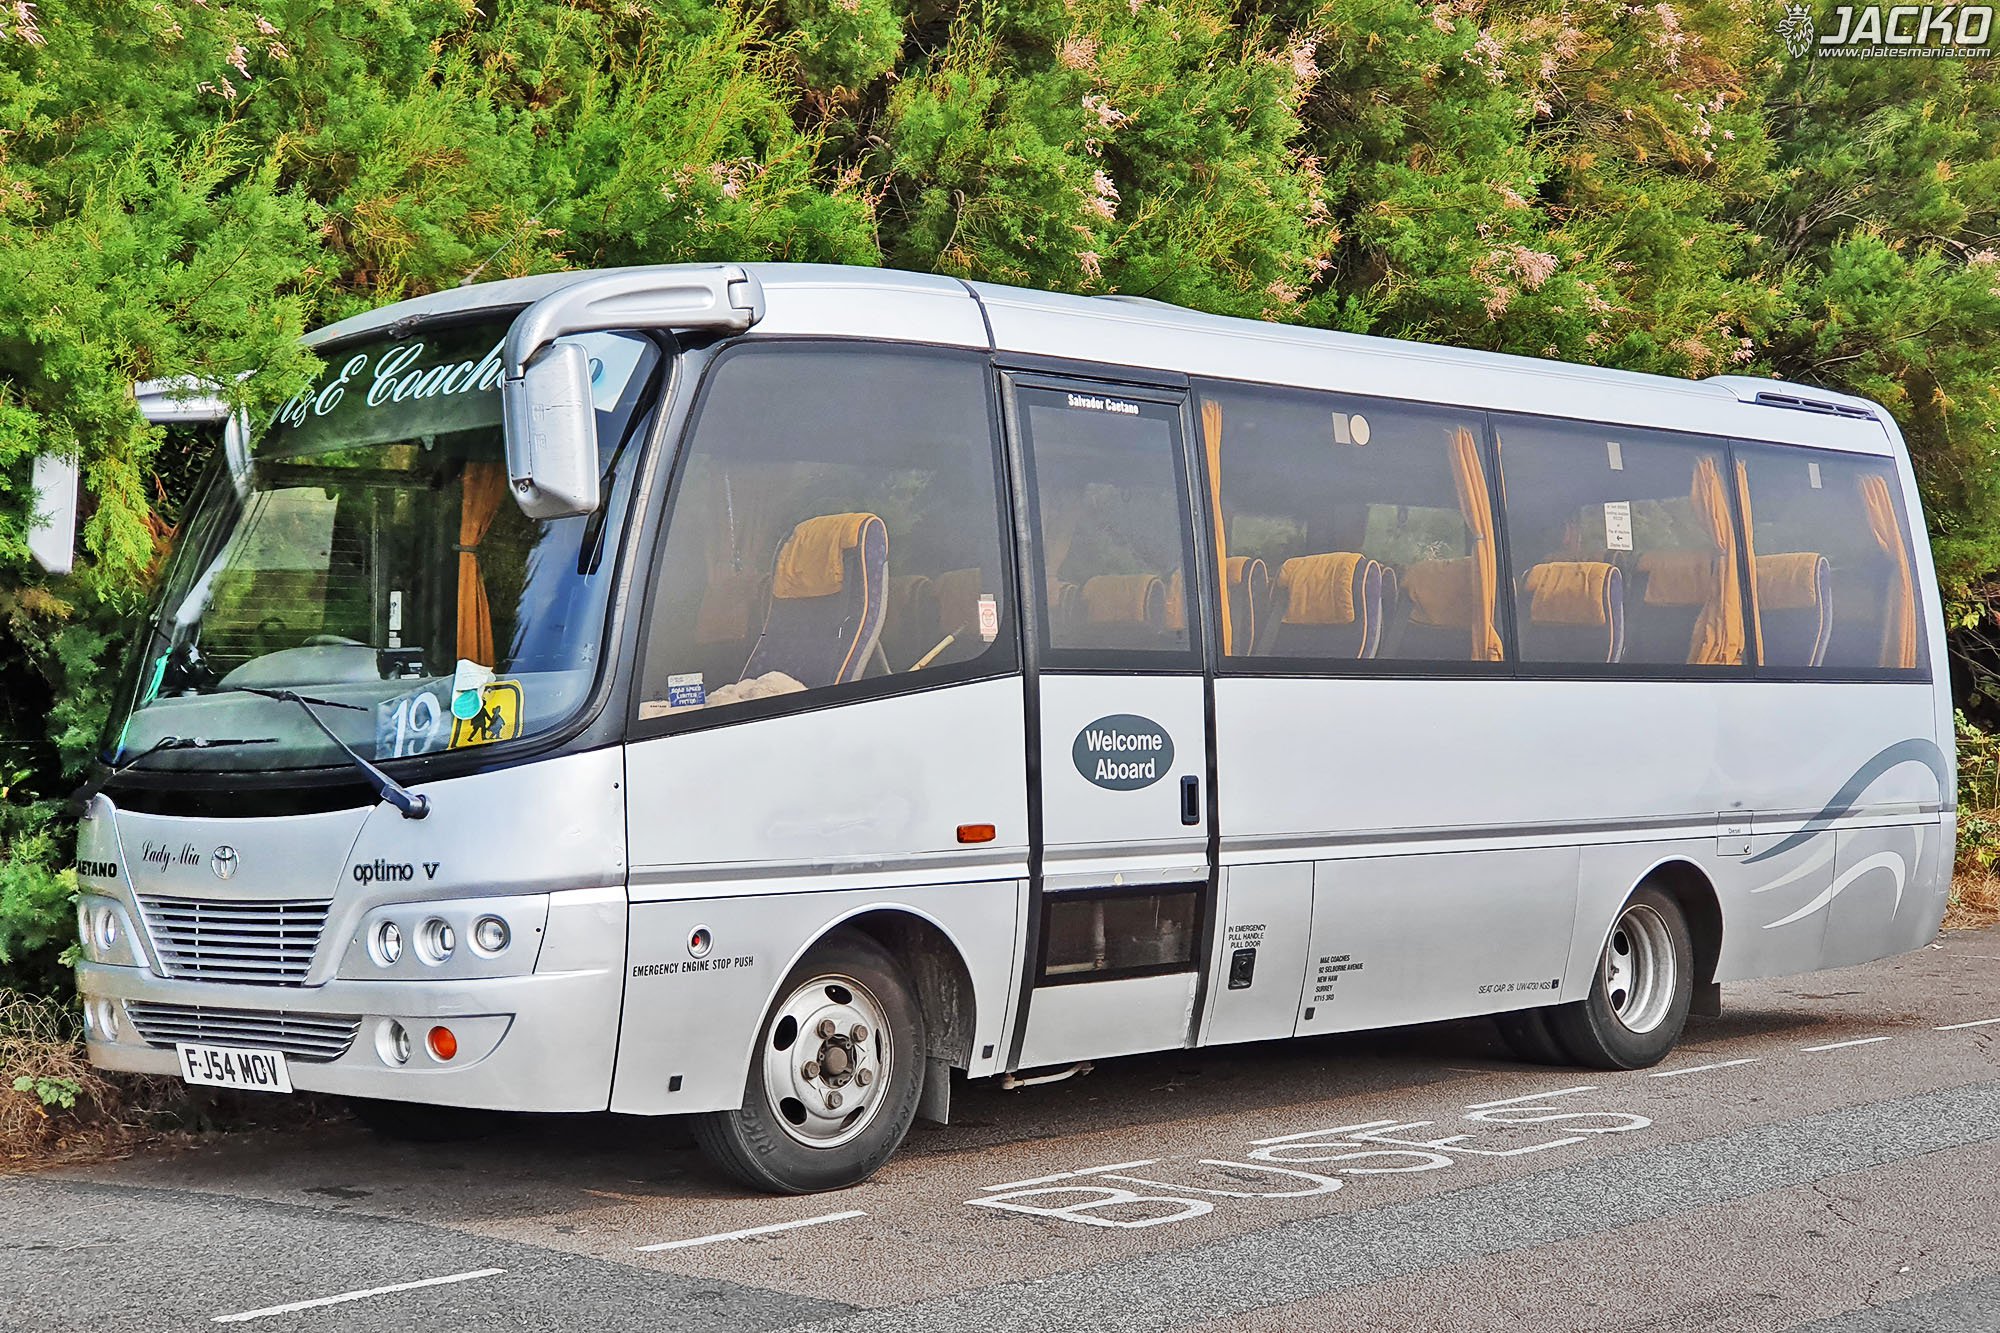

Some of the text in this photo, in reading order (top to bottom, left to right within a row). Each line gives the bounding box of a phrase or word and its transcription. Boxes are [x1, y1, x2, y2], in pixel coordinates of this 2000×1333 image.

[1067, 394, 1139, 415] Salvador Caetano
[391, 692, 441, 758] 19
[1086, 729, 1163, 752] Welcome
[1095, 757, 1156, 780] Aboard
[142, 840, 200, 873] Lady Mia
[353, 859, 414, 886] optimo
[1235, 924, 1266, 932] EMERGENCY
[1243, 932, 1264, 940] HANDLE
[1245, 940, 1261, 948] DOOR
[632, 955, 754, 977] EMERGENCY ENGINE STOP PUSH
[1331, 954, 1350, 962] COACHES
[1347, 963, 1364, 971] AVENUE
[1478, 985, 1492, 994] SEAT
[185, 1049, 278, 1086] FJ54 MOV
[962, 1085, 1654, 1229] BUSES
